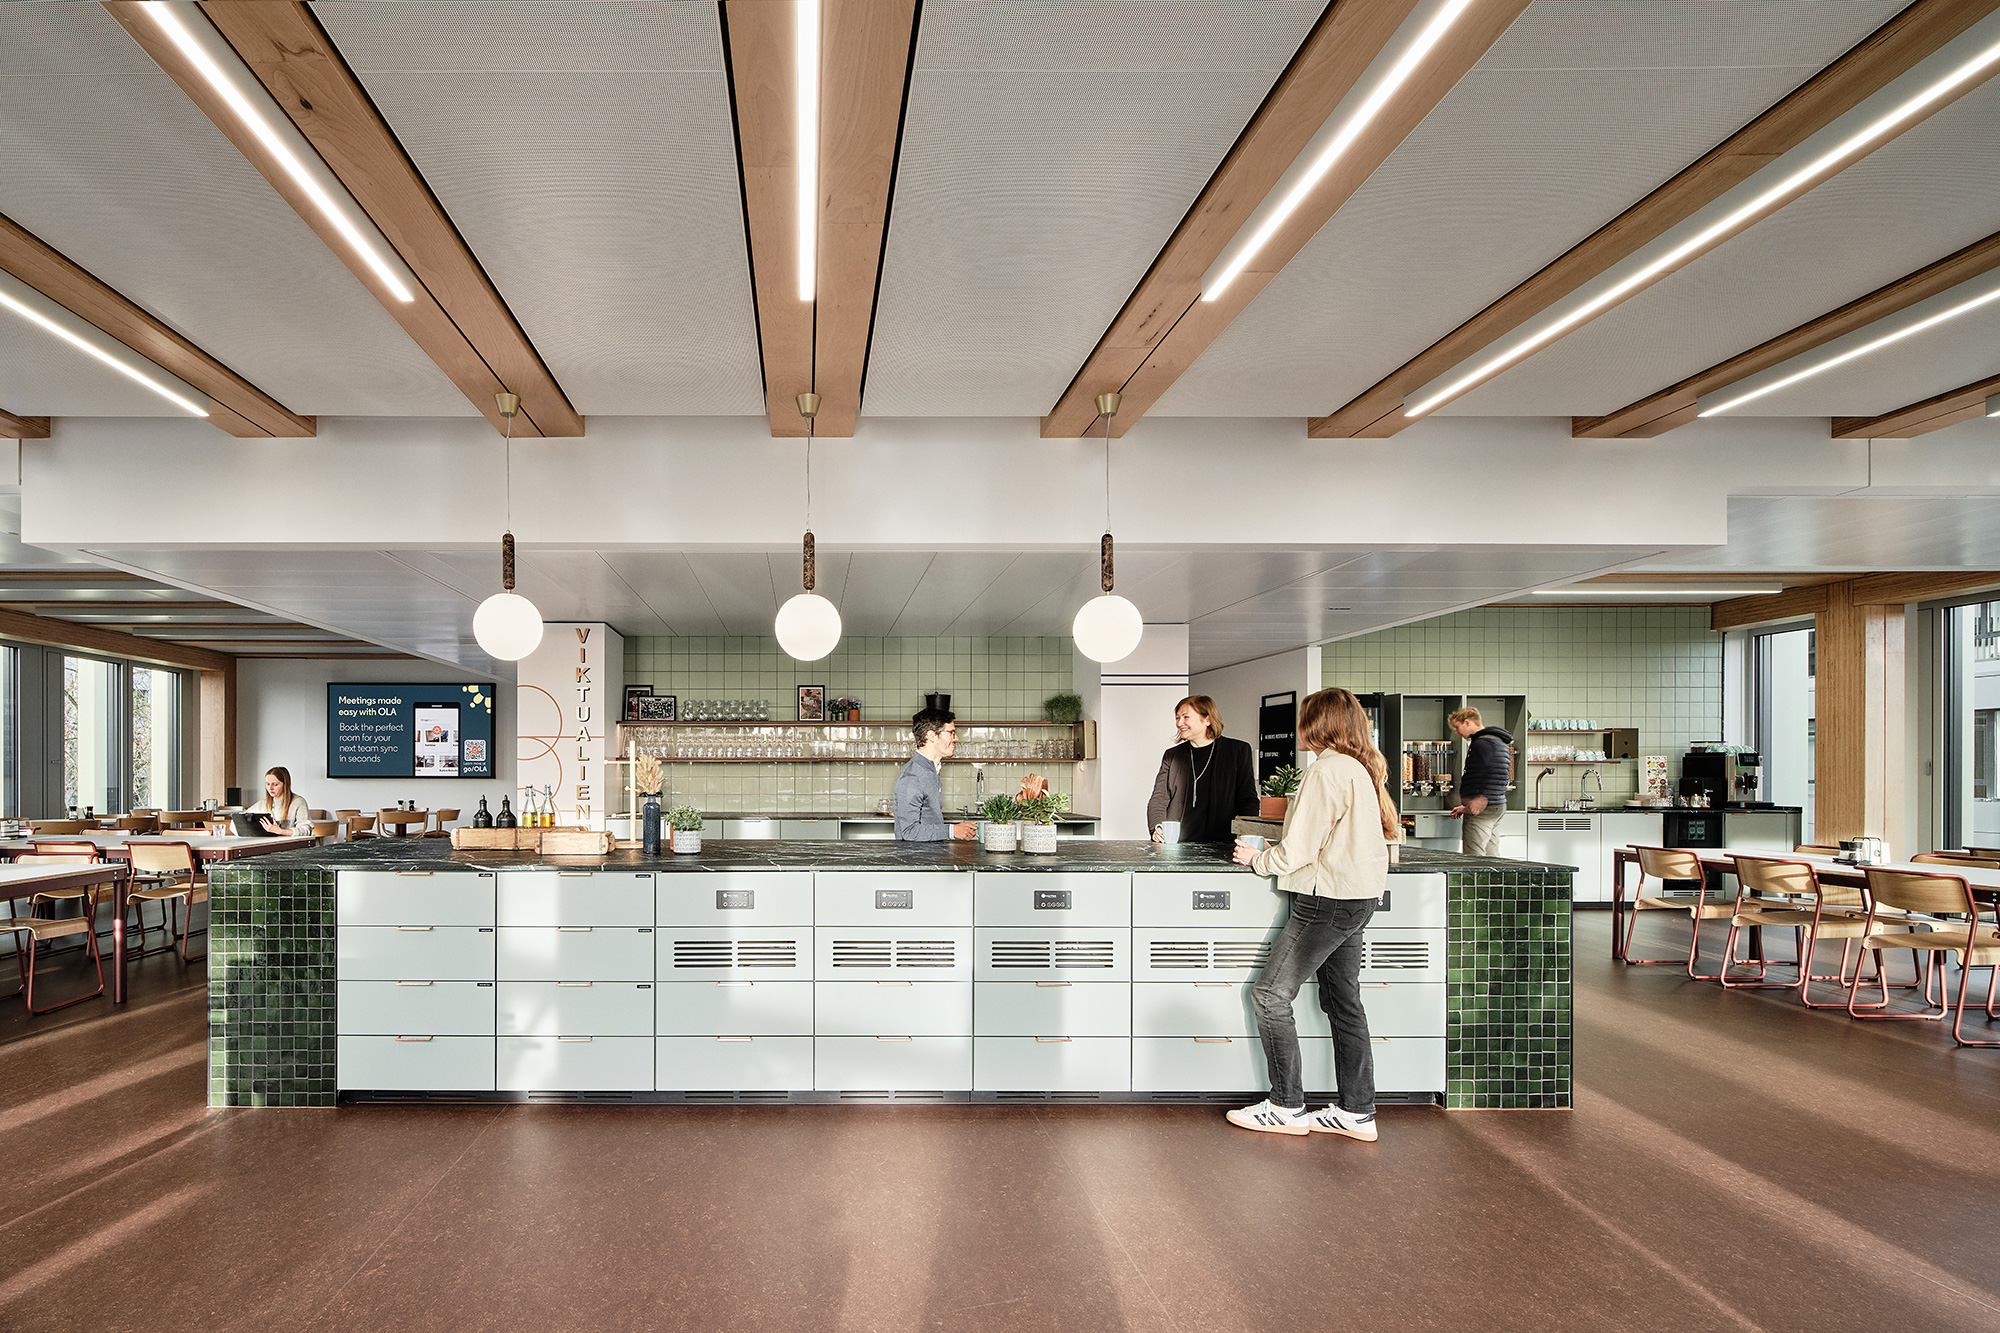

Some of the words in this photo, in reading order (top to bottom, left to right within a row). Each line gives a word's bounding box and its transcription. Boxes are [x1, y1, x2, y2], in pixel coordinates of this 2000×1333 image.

[338, 696, 376, 706] Meetings
[377, 696, 402, 705] made
[338, 709, 358, 718] easy
[359, 707, 377, 716] with
[378, 707, 397, 716] OLA
[339, 722, 360, 732] Book
[361, 722, 374, 732] the
[375, 722, 404, 733] perfect
[575, 628, 592, 832] VIKTUALIEN
[361, 732, 372, 742] for
[373, 735, 391, 744] your
[339, 744, 357, 752] next
[357, 744, 379, 752] team
[380, 745, 399, 754] sync
[339, 754, 347, 763] in
[348, 754, 381, 763] seconds
[463, 766, 488, 774] go/OLA
